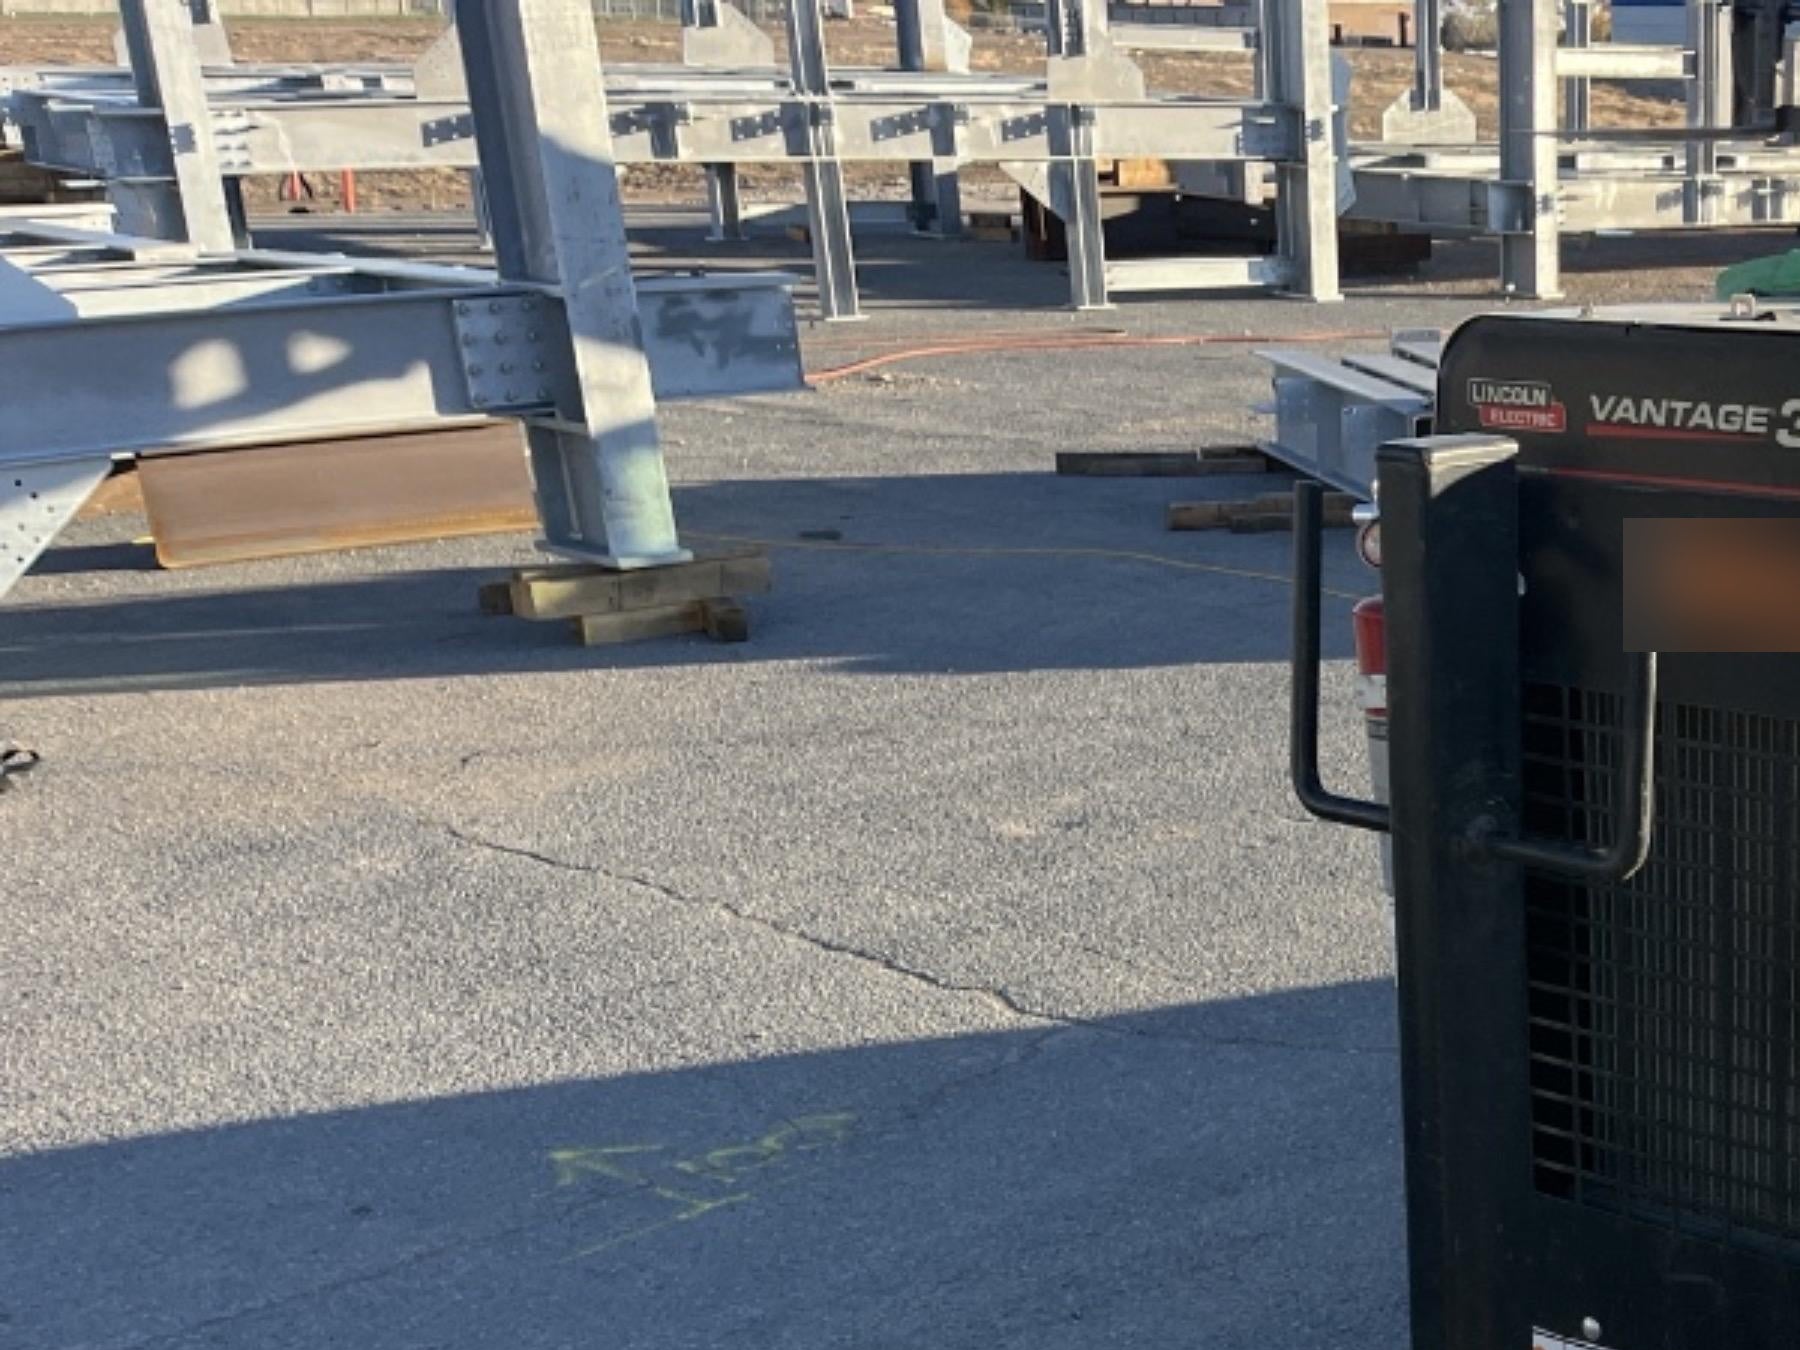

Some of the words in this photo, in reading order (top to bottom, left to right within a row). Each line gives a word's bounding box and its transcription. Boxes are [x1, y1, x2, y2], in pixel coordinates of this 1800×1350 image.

[1471, 382, 1547, 406] LINCOLN
[1489, 409, 1556, 428] ELECTRIC
[1590, 395, 1770, 433] VANTAGE
